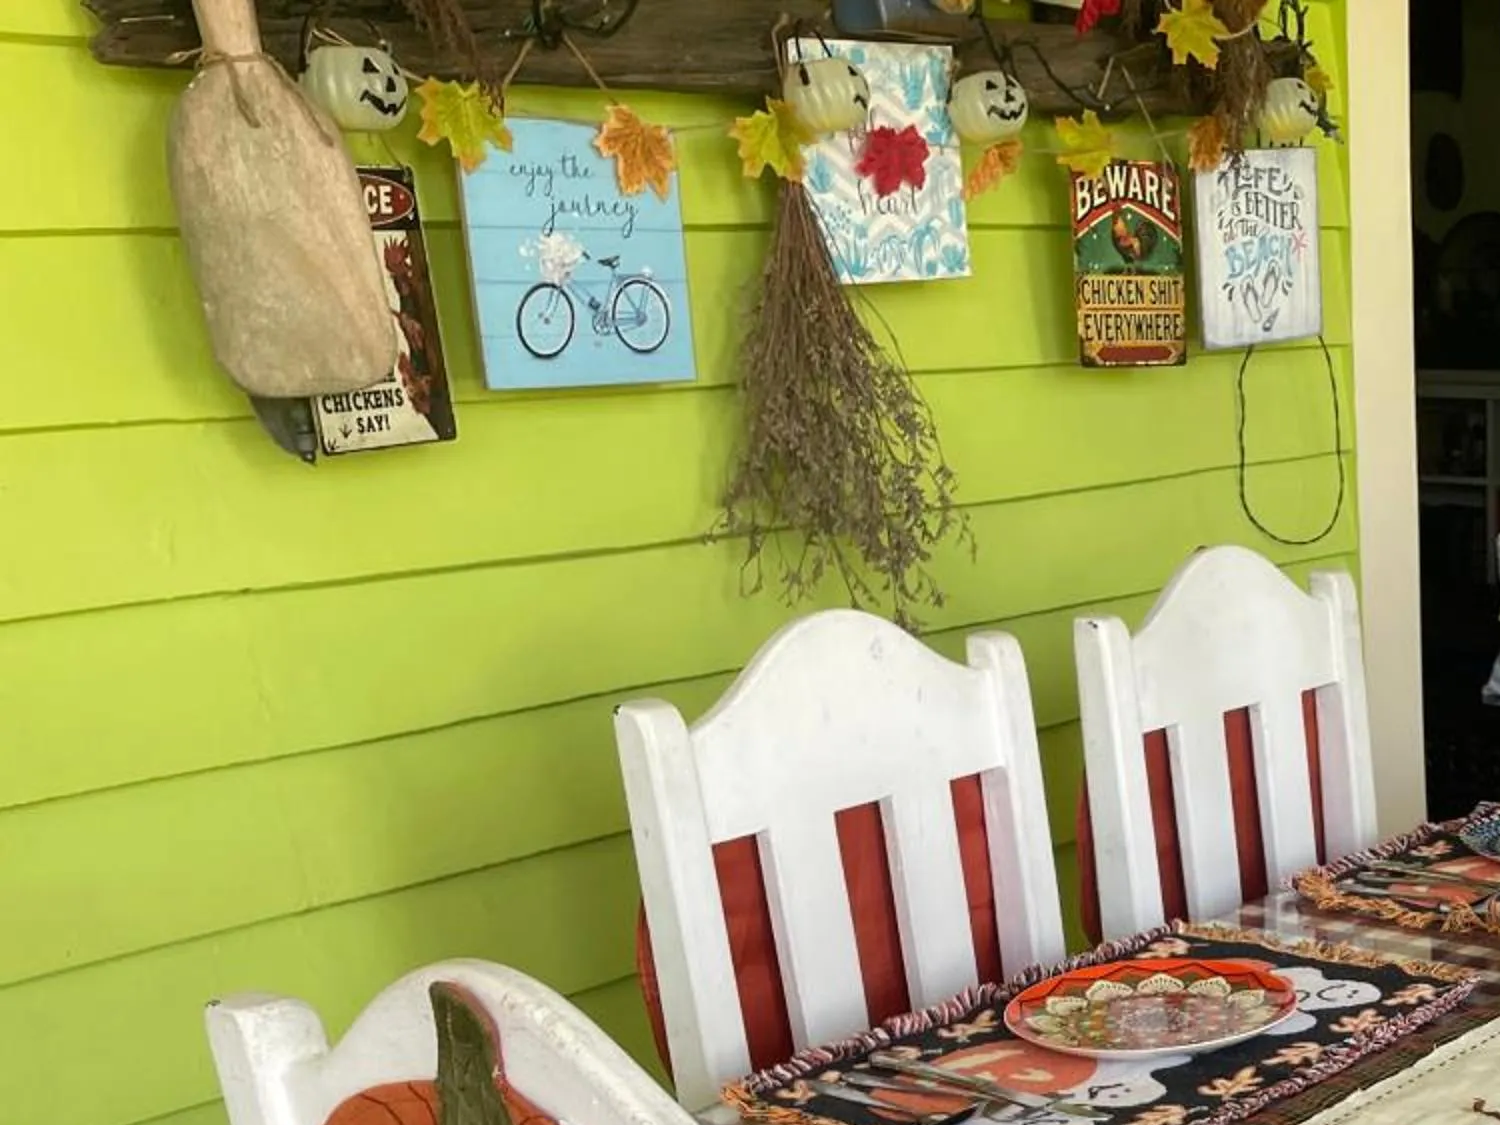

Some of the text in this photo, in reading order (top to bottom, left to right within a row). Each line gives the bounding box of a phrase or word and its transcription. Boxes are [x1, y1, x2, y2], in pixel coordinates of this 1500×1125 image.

[510, 154, 594, 196] enjoy the
[1075, 165, 1176, 221] BEWARE
[543, 194, 639, 238] journey
[1244, 191, 1303, 230] BETTER
[1225, 234, 1293, 278] BEACH
[1081, 280, 1181, 305] CHICKEN SHIT
[1084, 313, 1183, 341] EVERYWHERE
[321, 388, 404, 414] CHICKENS
[356, 414, 391, 433] SAY!
